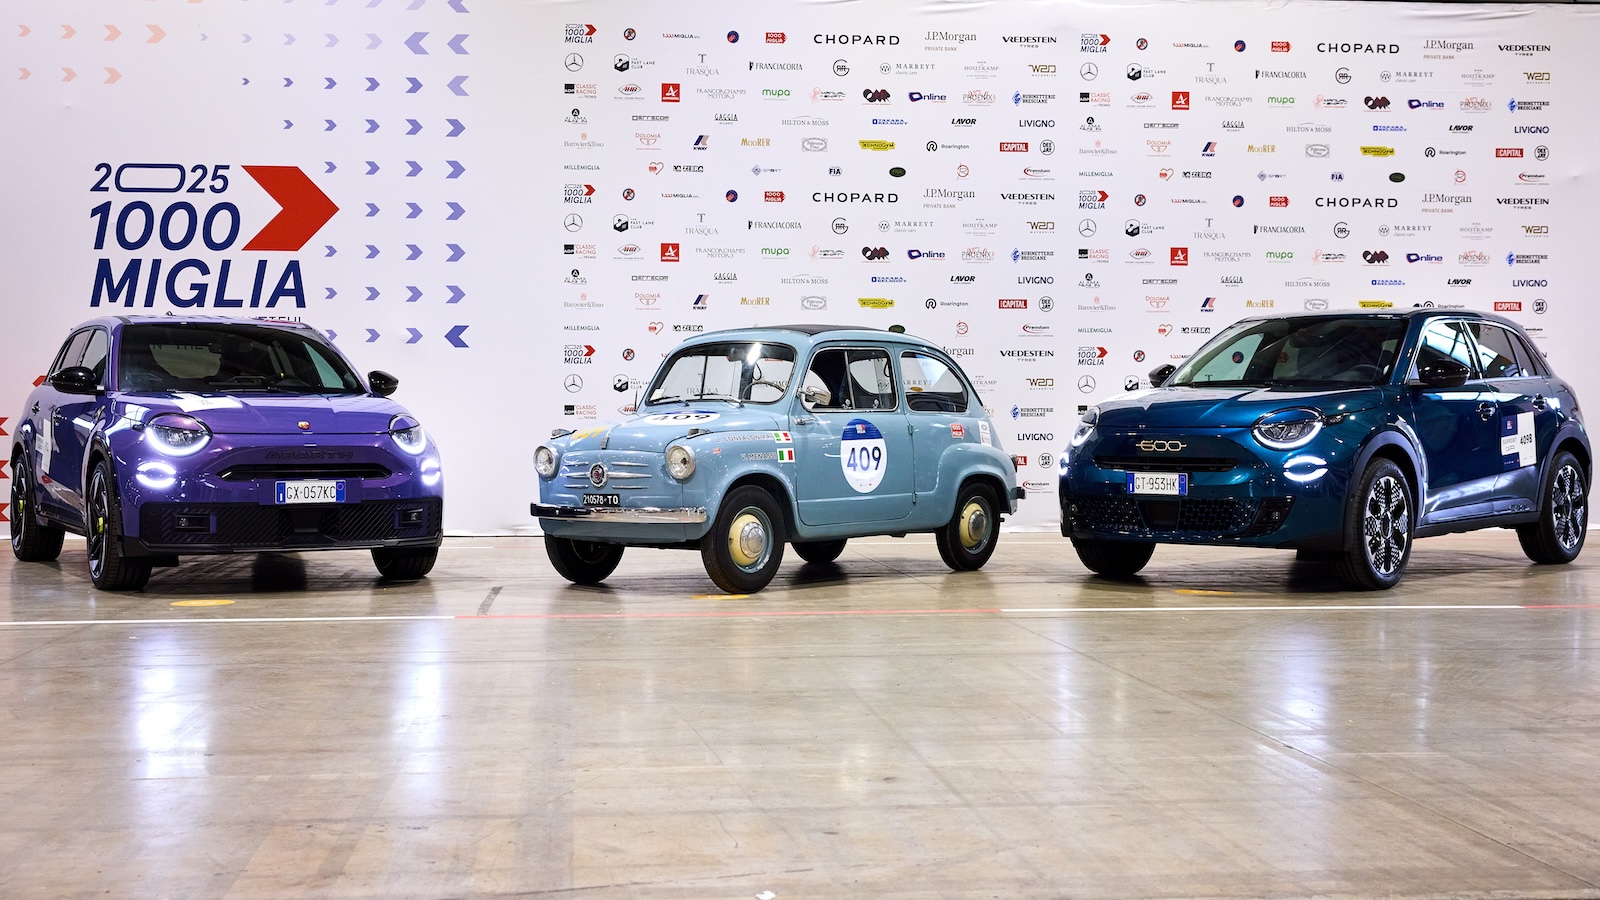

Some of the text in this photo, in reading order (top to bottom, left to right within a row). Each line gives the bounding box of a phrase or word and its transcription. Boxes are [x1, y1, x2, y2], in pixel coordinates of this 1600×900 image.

[565, 28, 584, 36] 1000
[813, 34, 900, 45] CHOPARD
[925, 31, 977, 43] J.P.Morgan
[1080, 45, 1107, 53] MIGLIA
[1317, 43, 1399, 54] CHOPARD
[1424, 40, 1473, 52] J.P.Morgan
[755, 62, 803, 71] FRANCIACORTA
[686, 68, 720, 76] TRASQUA
[1261, 71, 1306, 79] FRANCIACORTA
[762, 88, 791, 97] mupa
[1268, 96, 1295, 105] mupa
[714, 113, 738, 121] GAGGIA
[1514, 126, 1550, 134] LIVIGNO
[1003, 143, 1027, 151] CAPITAL
[564, 188, 583, 196] 1000
[923, 188, 975, 200] J.P.Morgan
[812, 192, 898, 203] CHOPARD
[1422, 193, 1472, 205] J.P.Morgan
[1315, 197, 1398, 208] CHOPARD
[90, 200, 241, 251] 1000
[754, 221, 802, 229] FRANCIACORTA
[1260, 225, 1305, 234] FRANCIACORTA
[761, 247, 790, 256] mupa
[1266, 251, 1294, 260] mupa
[90, 258, 306, 308] MIGLIA
[1018, 276, 1054, 284] LIVIGNO
[564, 349, 583, 357] 1000
[1078, 358, 1104, 366] MIGLIA
[1017, 433, 1054, 441] LIVIGNO
[1520, 433, 1533, 446] 409B
[1136, 440, 1187, 452] 600
[265, 450, 353, 460] ABARTH
[847, 446, 882, 472] 409
[583, 495, 619, 505] 210578 TO
